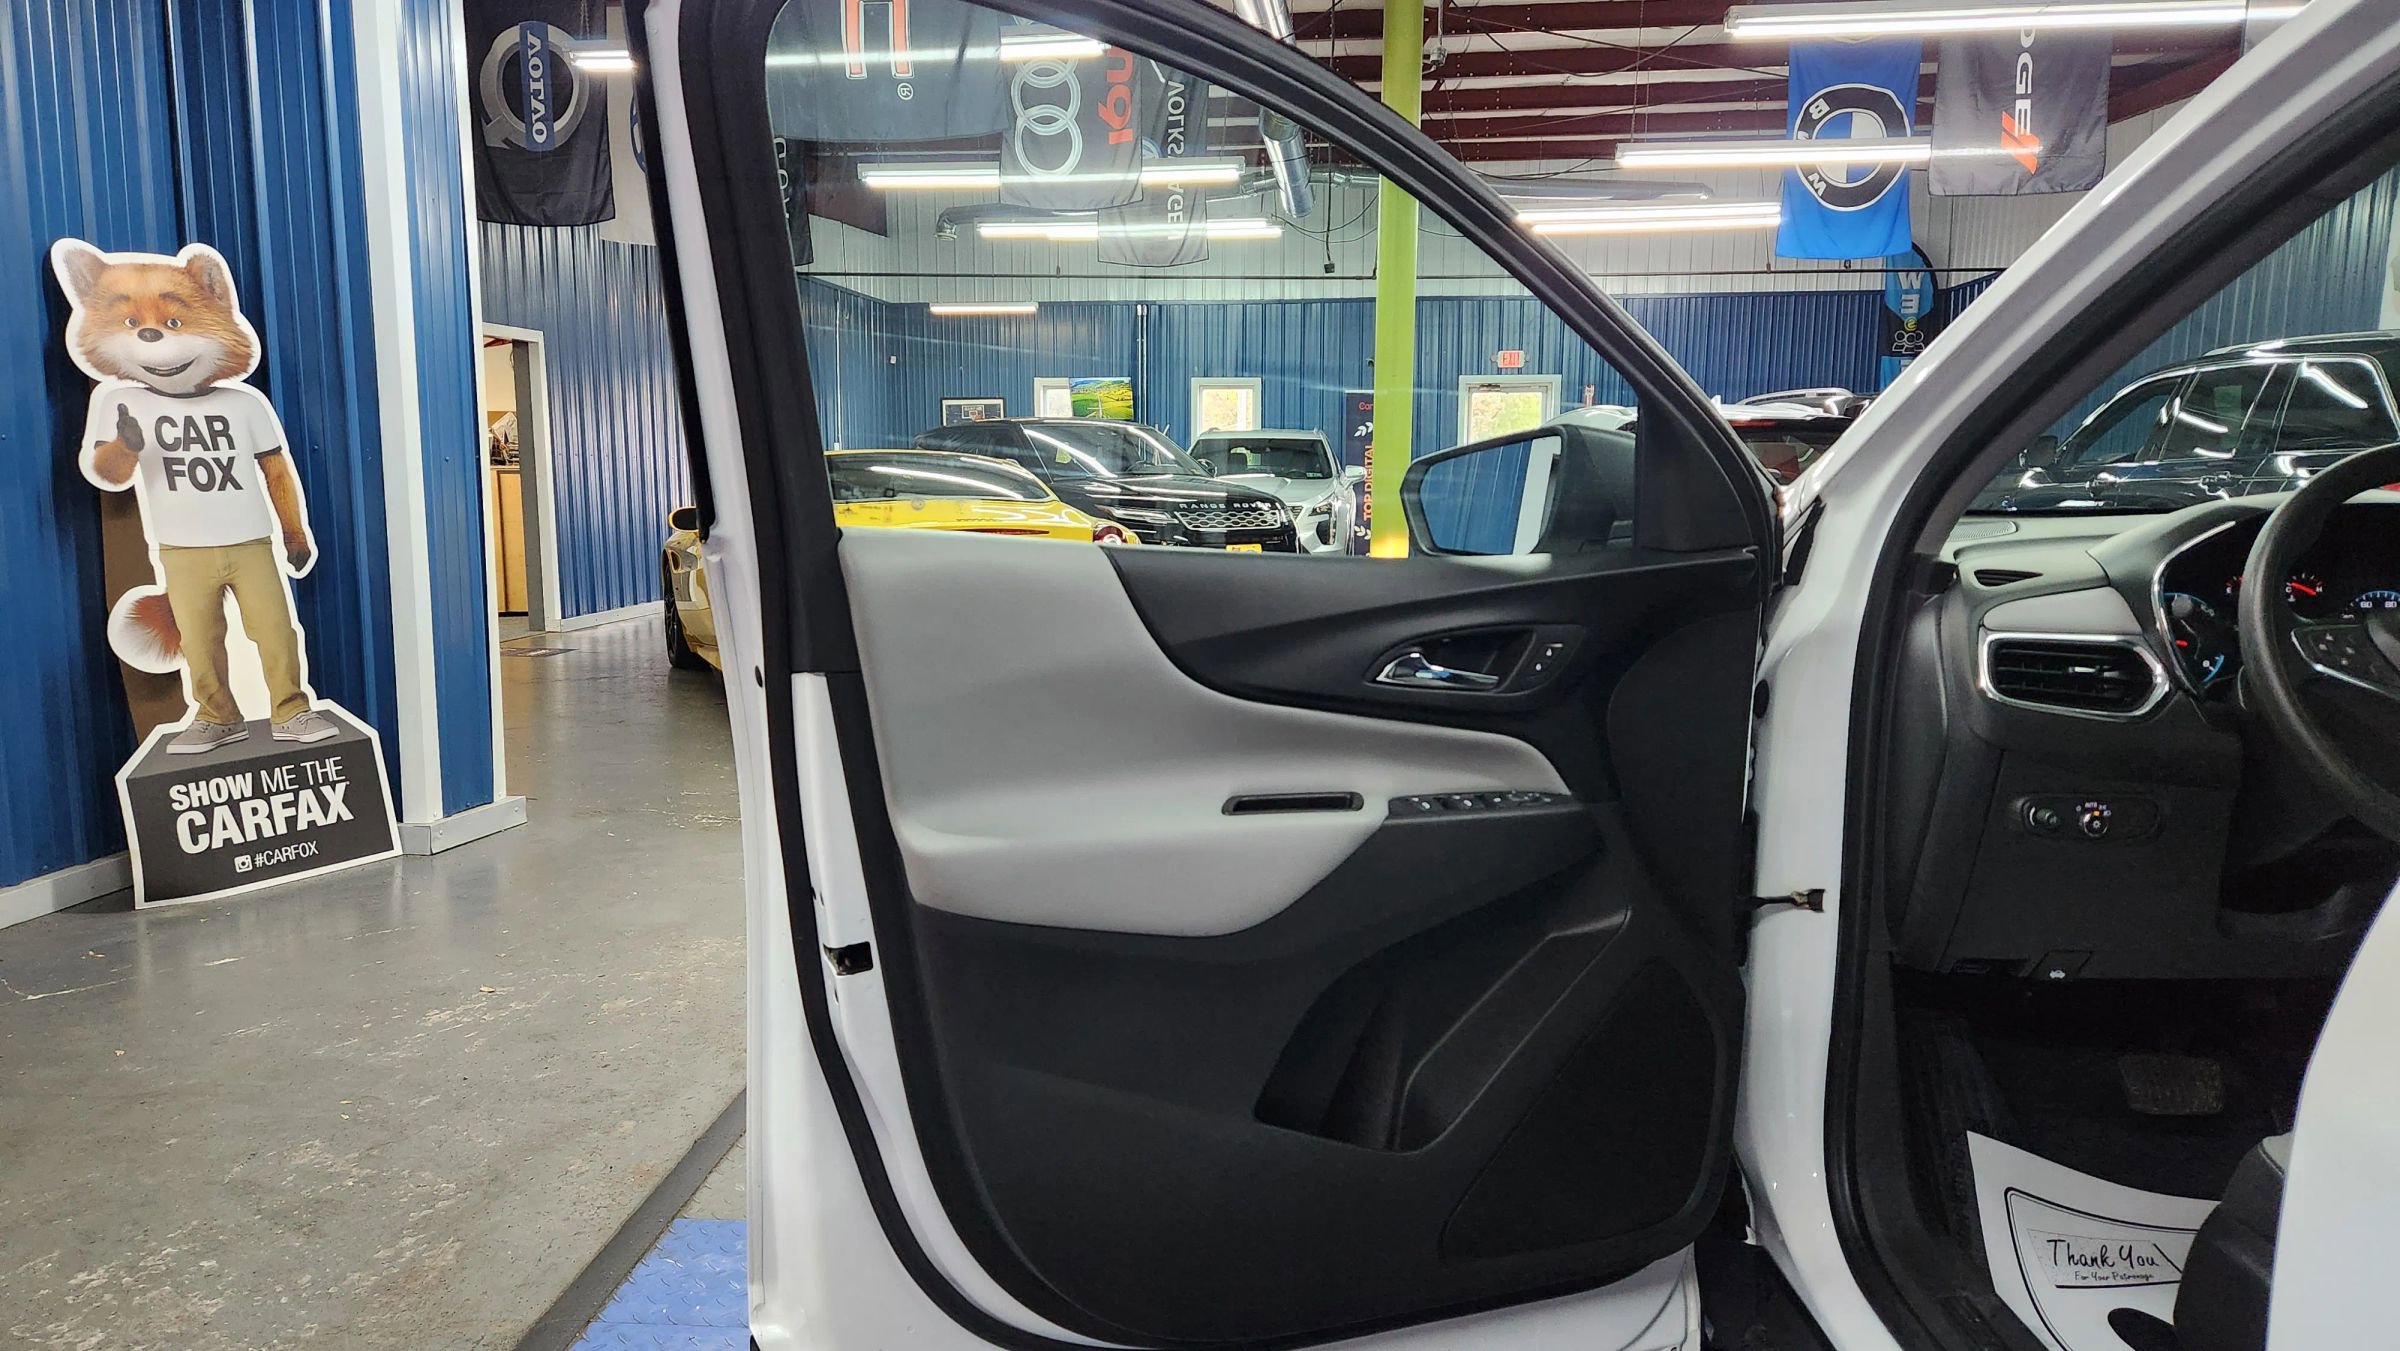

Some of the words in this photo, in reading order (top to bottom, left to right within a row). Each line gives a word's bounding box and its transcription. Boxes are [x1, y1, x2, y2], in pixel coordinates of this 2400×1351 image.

[155, 415, 236, 452] CAR
[162, 456, 244, 492] FOX
[169, 772, 253, 811] SHOW
[260, 764, 299, 794] ME
[300, 756, 346, 786] THE
[176, 783, 355, 855] CARFAX
[254, 841, 319, 868] #CARFOX
[2046, 1239, 2116, 1267] Thank
[2119, 1244, 2160, 1269] You
[2074, 1271, 2089, 1281] For
[2091, 1271, 2111, 1281] Your
